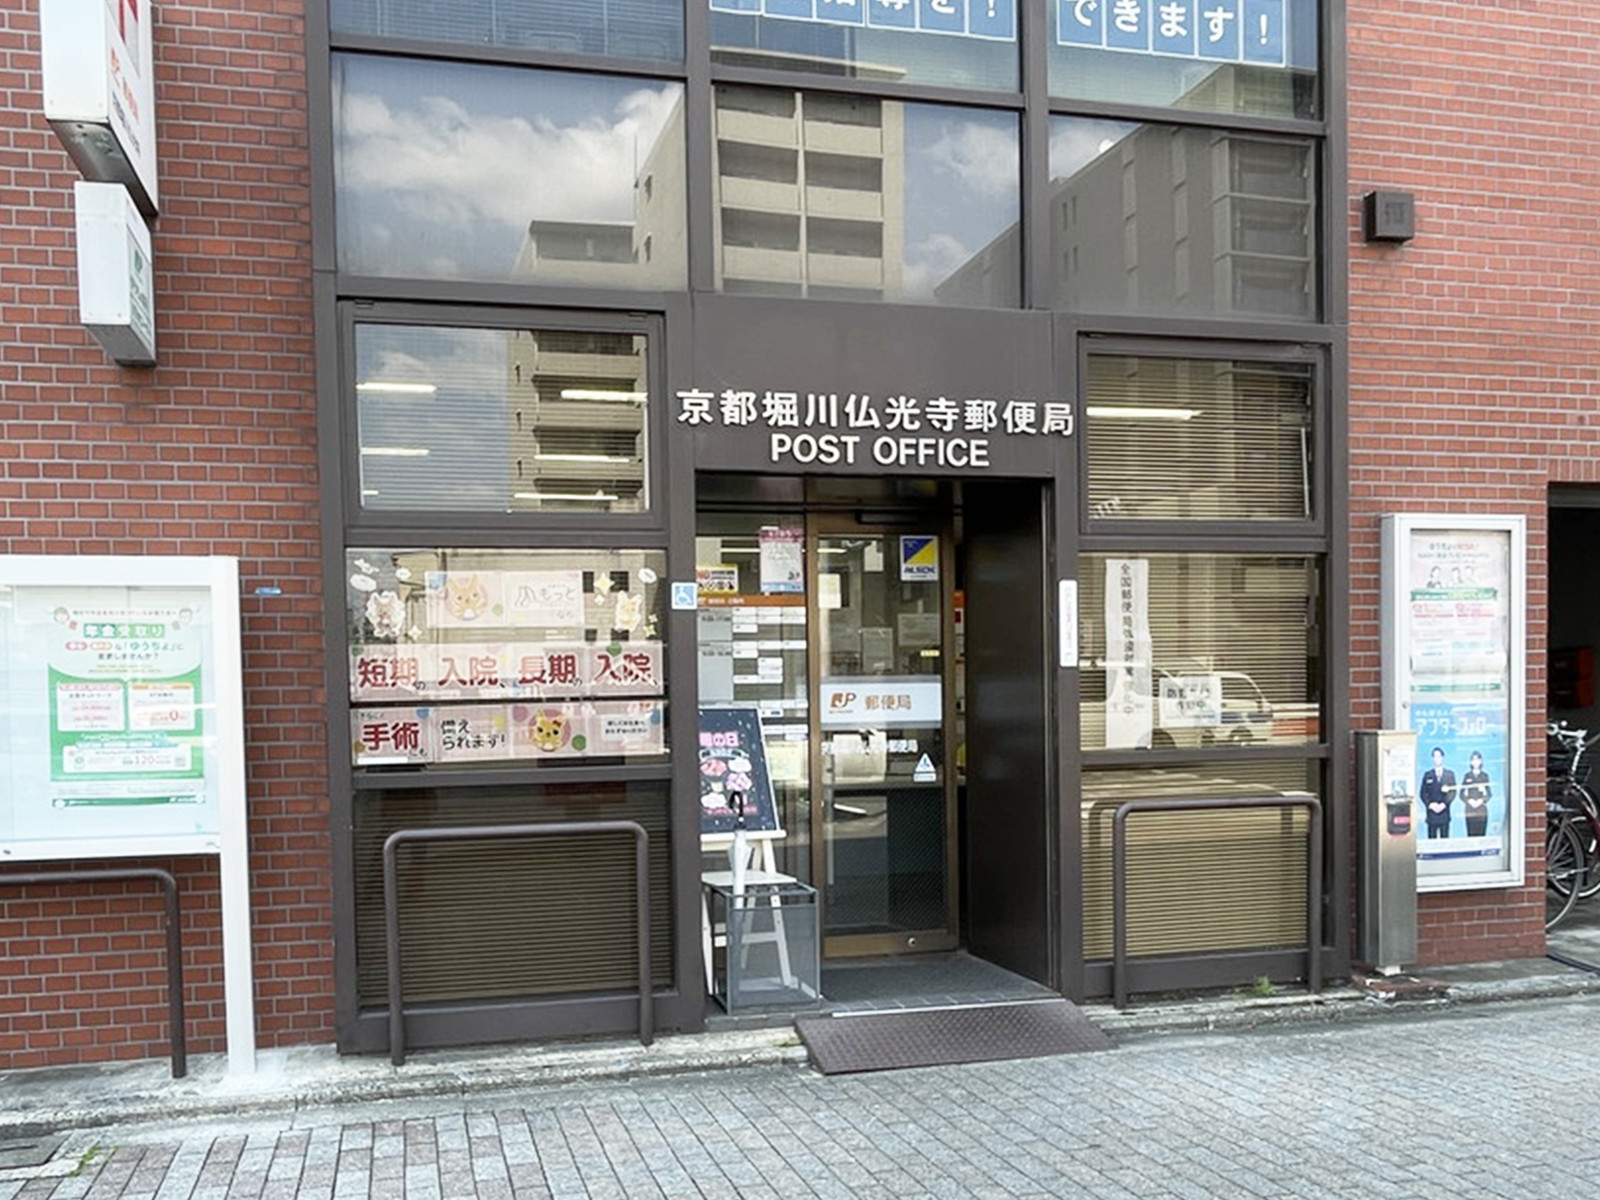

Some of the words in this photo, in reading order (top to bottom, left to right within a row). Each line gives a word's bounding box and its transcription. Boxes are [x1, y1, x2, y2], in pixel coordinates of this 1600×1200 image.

[676, 389, 1074, 436] 京都堀川仏光寺郵便局
[771, 433, 861, 464] POST
[873, 436, 991, 467] OFFICE
[865, 694, 912, 710] 郵便局
